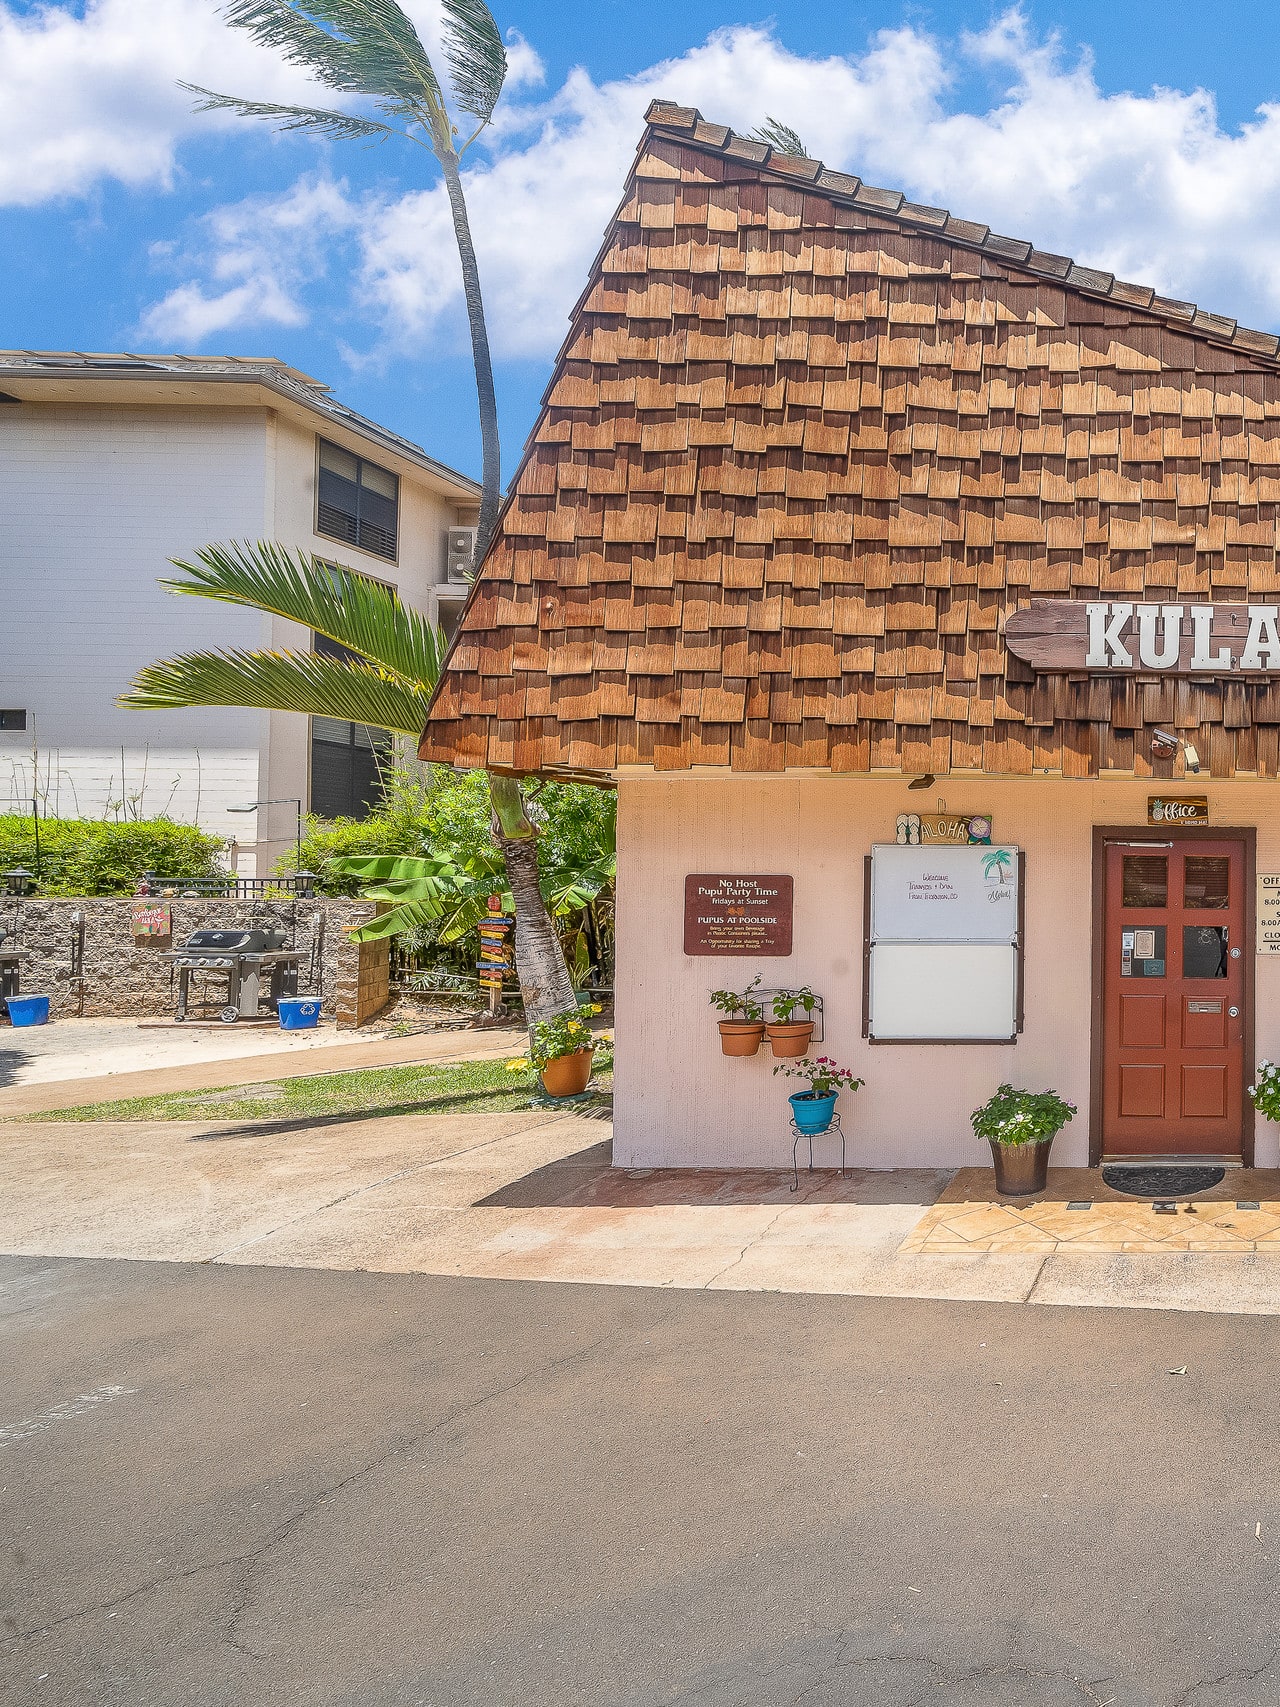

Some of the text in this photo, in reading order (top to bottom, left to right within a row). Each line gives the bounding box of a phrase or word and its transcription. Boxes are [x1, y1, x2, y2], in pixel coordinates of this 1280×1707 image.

[920, 821, 967, 840] ALOHA
[719, 879, 758, 888] No Host
[698, 887, 778, 898] Pupu Party Time
[712, 897, 735, 906] Fridays
[746, 897, 769, 905] Sunset
[697, 916, 778, 924] PUPUS AT POOLSIDE
